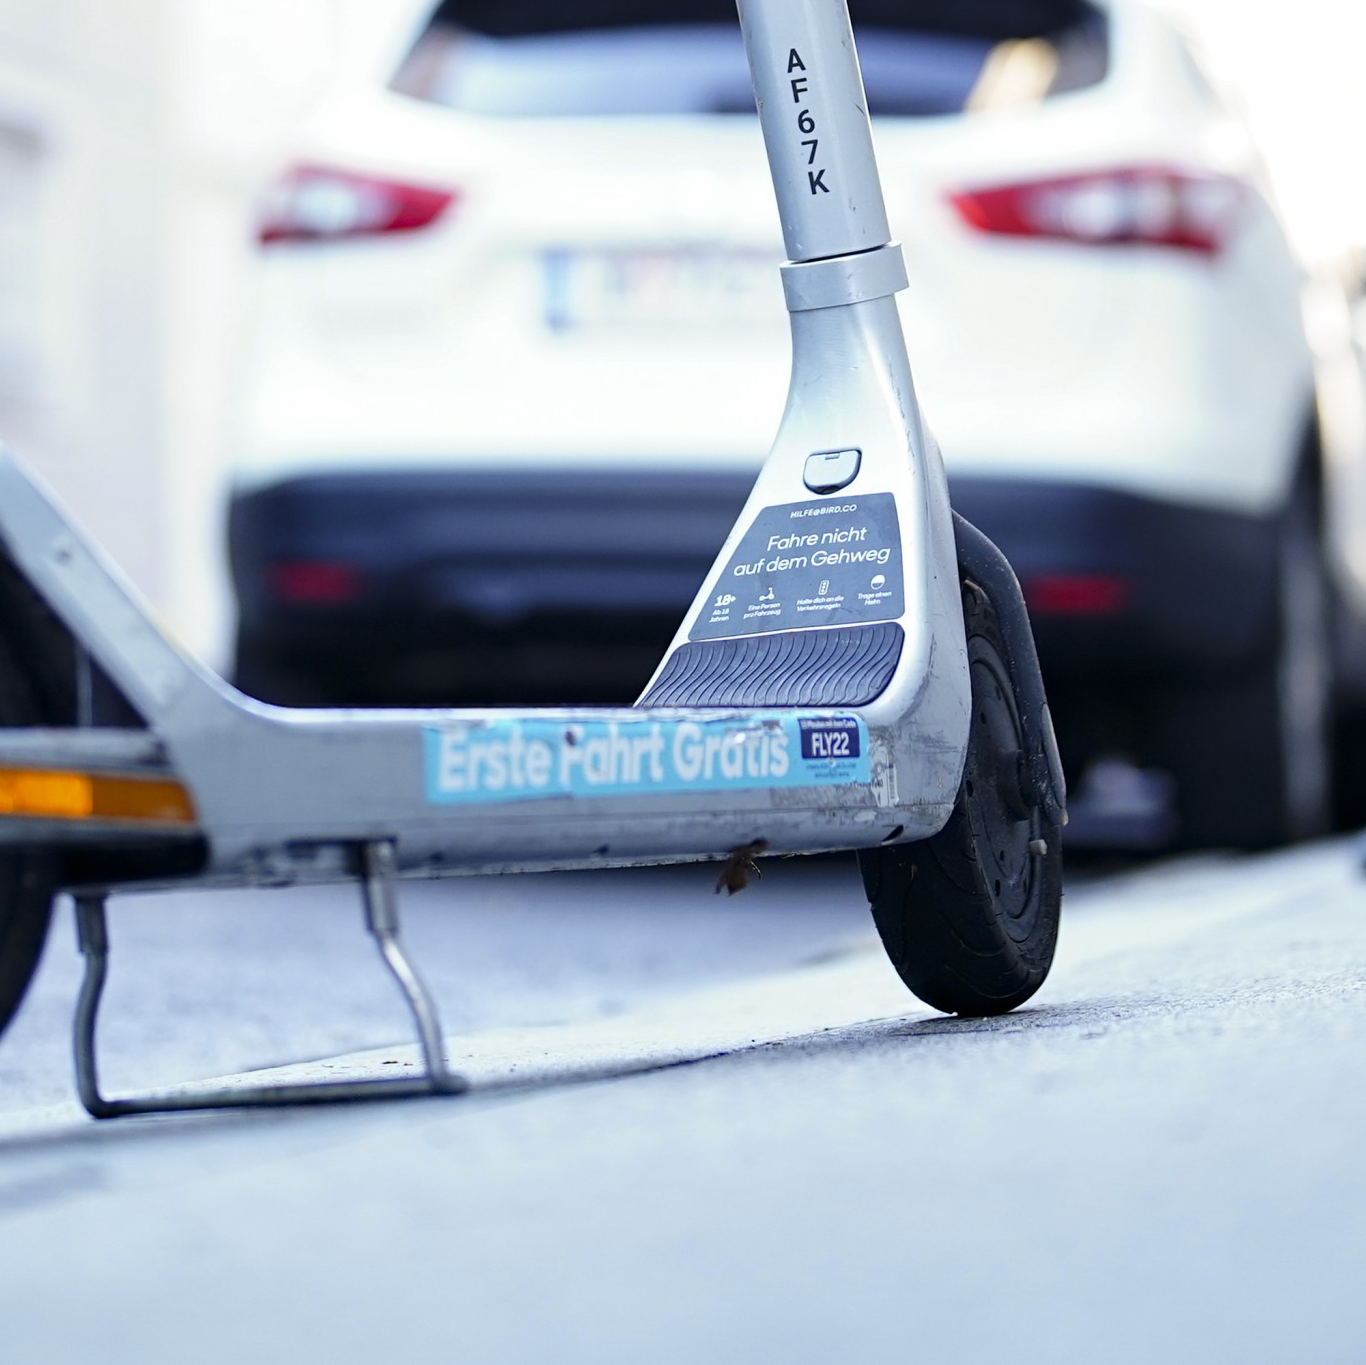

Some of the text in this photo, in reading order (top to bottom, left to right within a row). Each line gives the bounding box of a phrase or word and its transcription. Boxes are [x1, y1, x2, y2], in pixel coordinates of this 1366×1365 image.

[787, 48, 830, 195] AF67K
[790, 504, 857, 519] HILFE@BIRD.CO
[767, 527, 867, 551] Fahre nicht
[733, 548, 891, 576] auf dem Gehweg
[714, 594, 736, 607] 18+
[797, 603, 842, 612] Verkehrsregeln
[813, 596, 826, 604] dich
[755, 609, 782, 617] Fahrzeug
[812, 732, 850, 757] FLY22
[439, 721, 789, 791] Erste Fahrt Gratis
